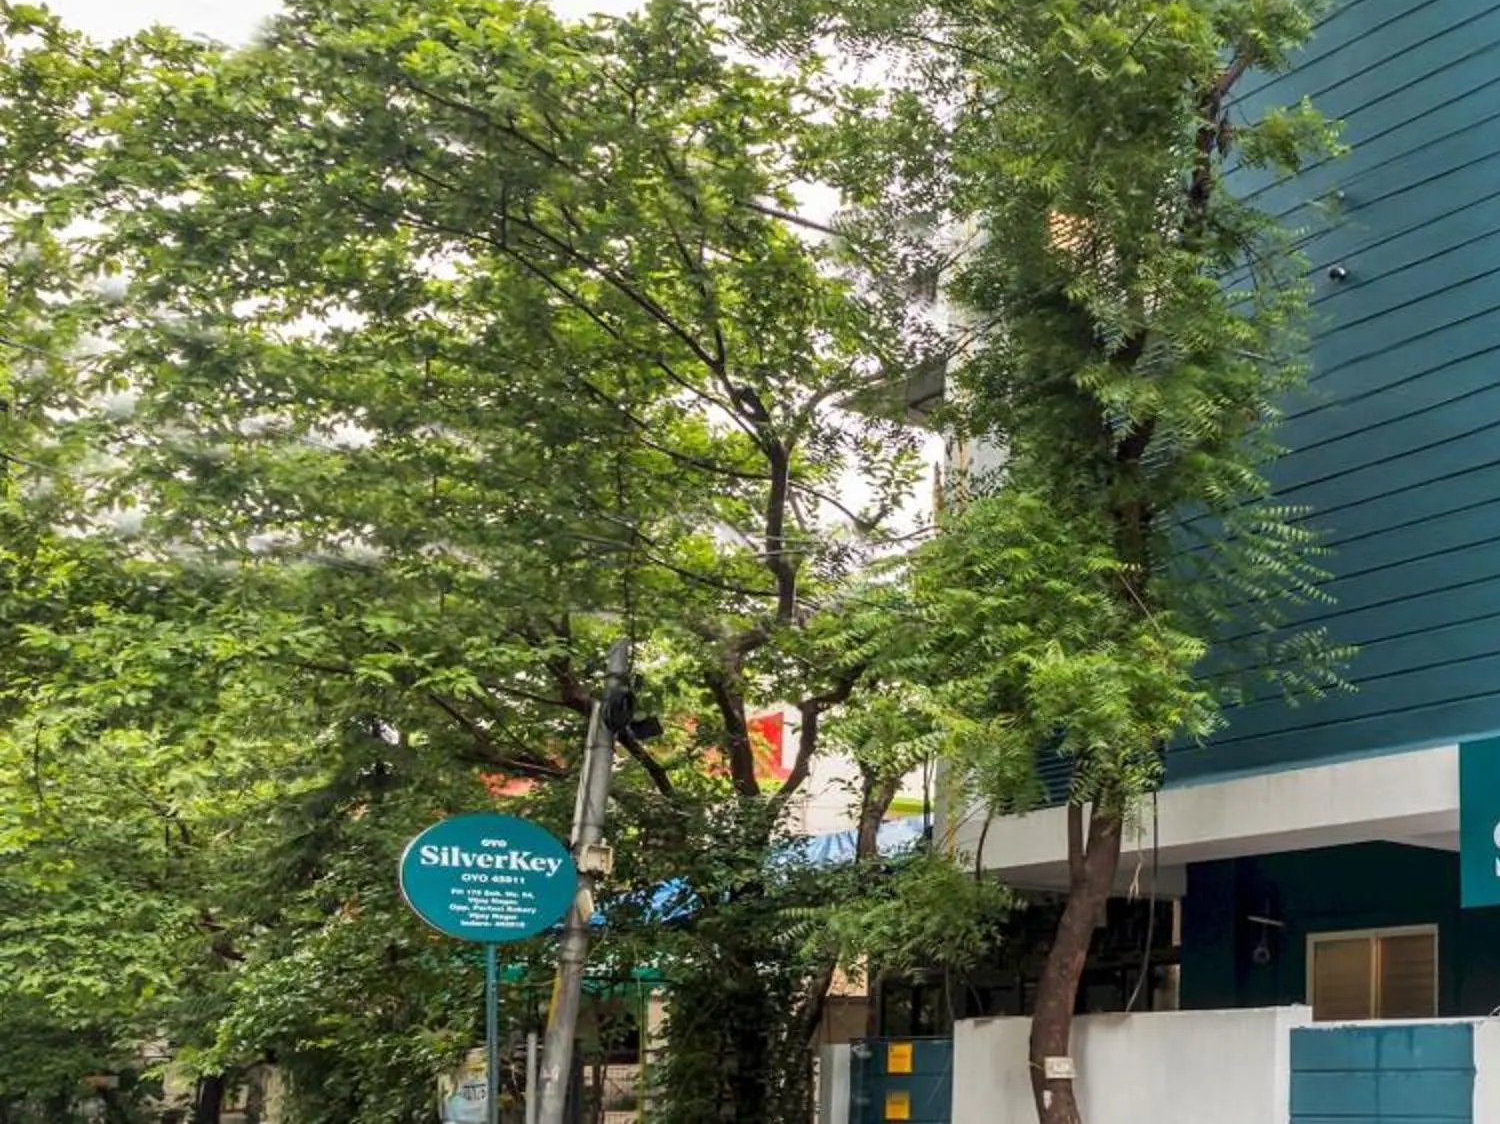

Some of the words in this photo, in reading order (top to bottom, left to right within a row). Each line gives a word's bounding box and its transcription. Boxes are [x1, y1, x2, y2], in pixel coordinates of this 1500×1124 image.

[481, 838, 507, 848] OYO
[420, 845, 563, 877] SilverKey
[461, 873, 489, 883] OYO
